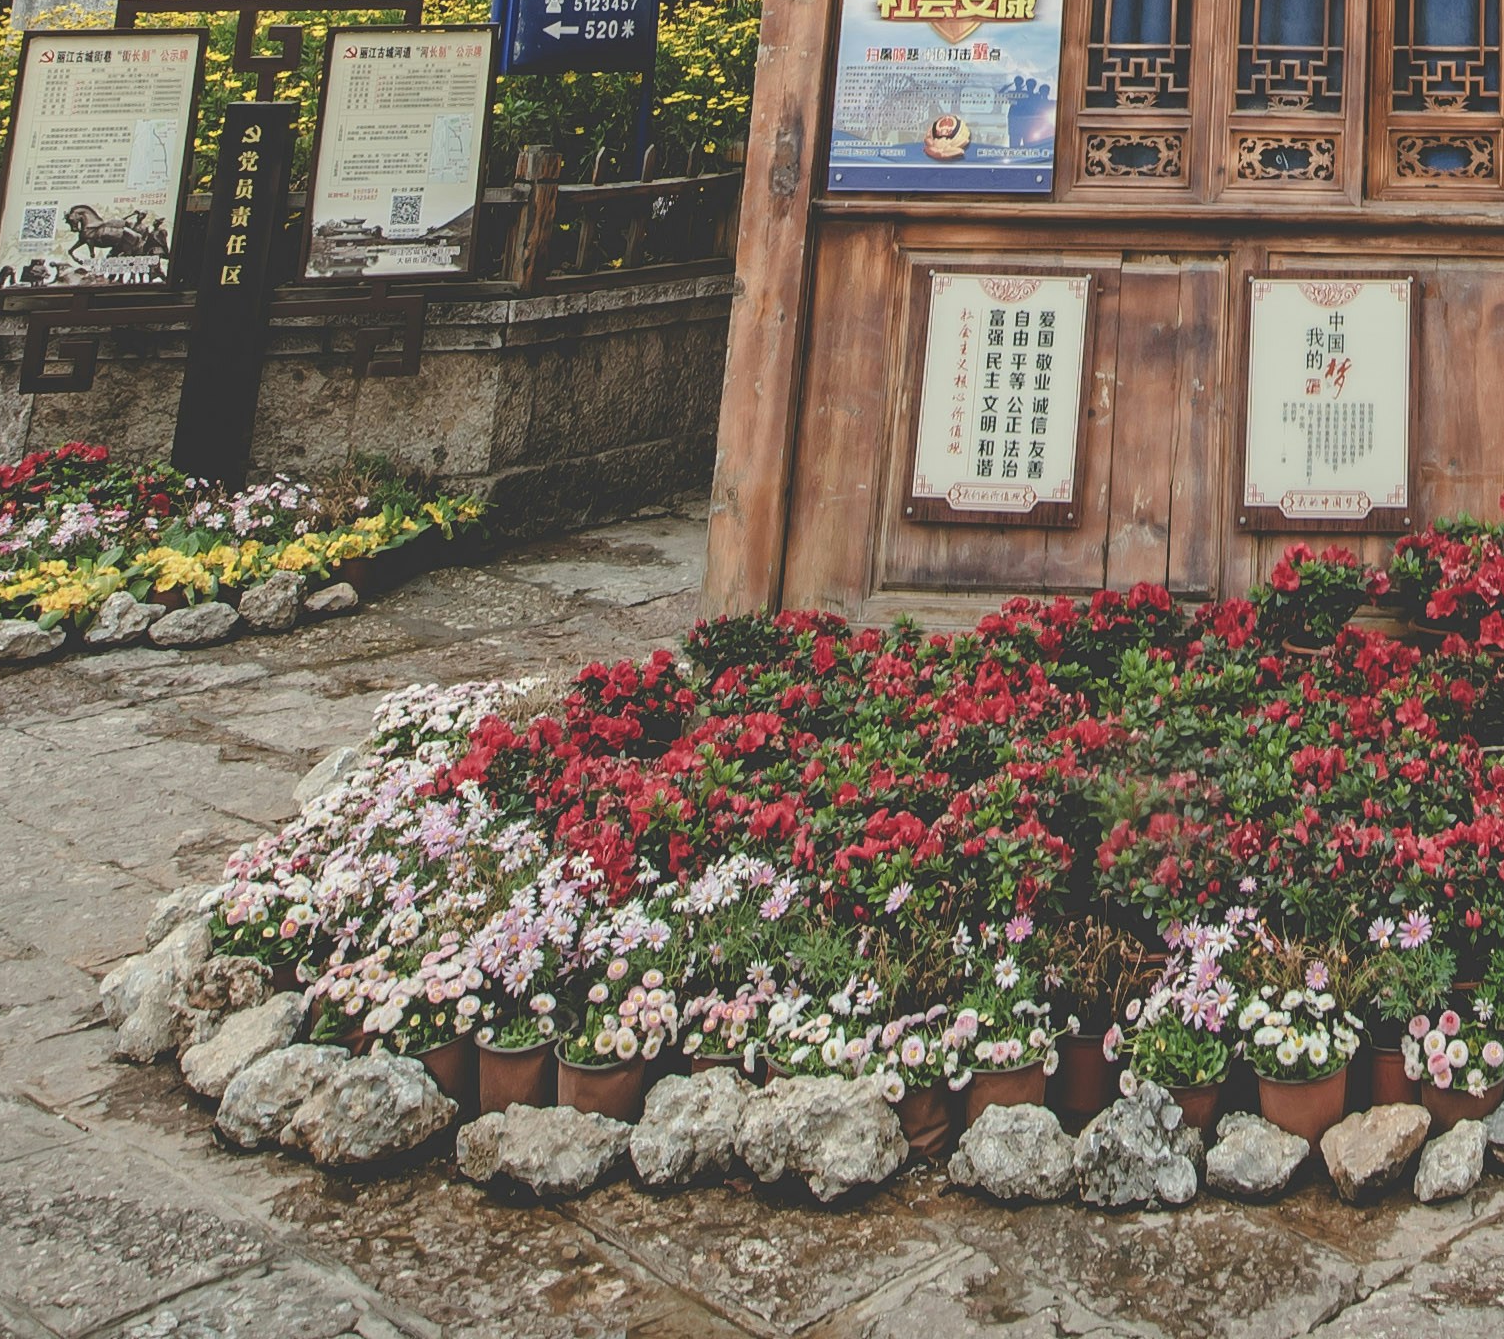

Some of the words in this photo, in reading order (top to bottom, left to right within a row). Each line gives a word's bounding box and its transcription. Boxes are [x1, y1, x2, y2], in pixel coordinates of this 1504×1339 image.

[584, 19, 635, 40] 520米
[56, 50, 112, 63] 丽江古城街巷
[159, 49, 189, 62] 公示牌
[359, 46, 411, 59] 丽江古城河道
[456, 45, 483, 58] 公示牌
[221, 150, 260, 285] 党员责任区
[987, 309, 1006, 347] 富强
[1012, 310, 1030, 348] 自由
[1037, 310, 1056, 348] 爱国
[1305, 327, 1325, 371] 我的
[946, 308, 975, 456] 社会主义核心价值观
[983, 352, 1002, 390] 民主
[1008, 352, 1027, 391] 平等
[1033, 353, 1052, 392] 敬业
[980, 395, 998, 434] 文明
[1004, 396, 1024, 435] 公正
[1030, 396, 1049, 436] 诚信
[976, 439, 995, 478] 和谐
[1001, 439, 1021, 479] 法治
[1026, 440, 1046, 480] 友善
